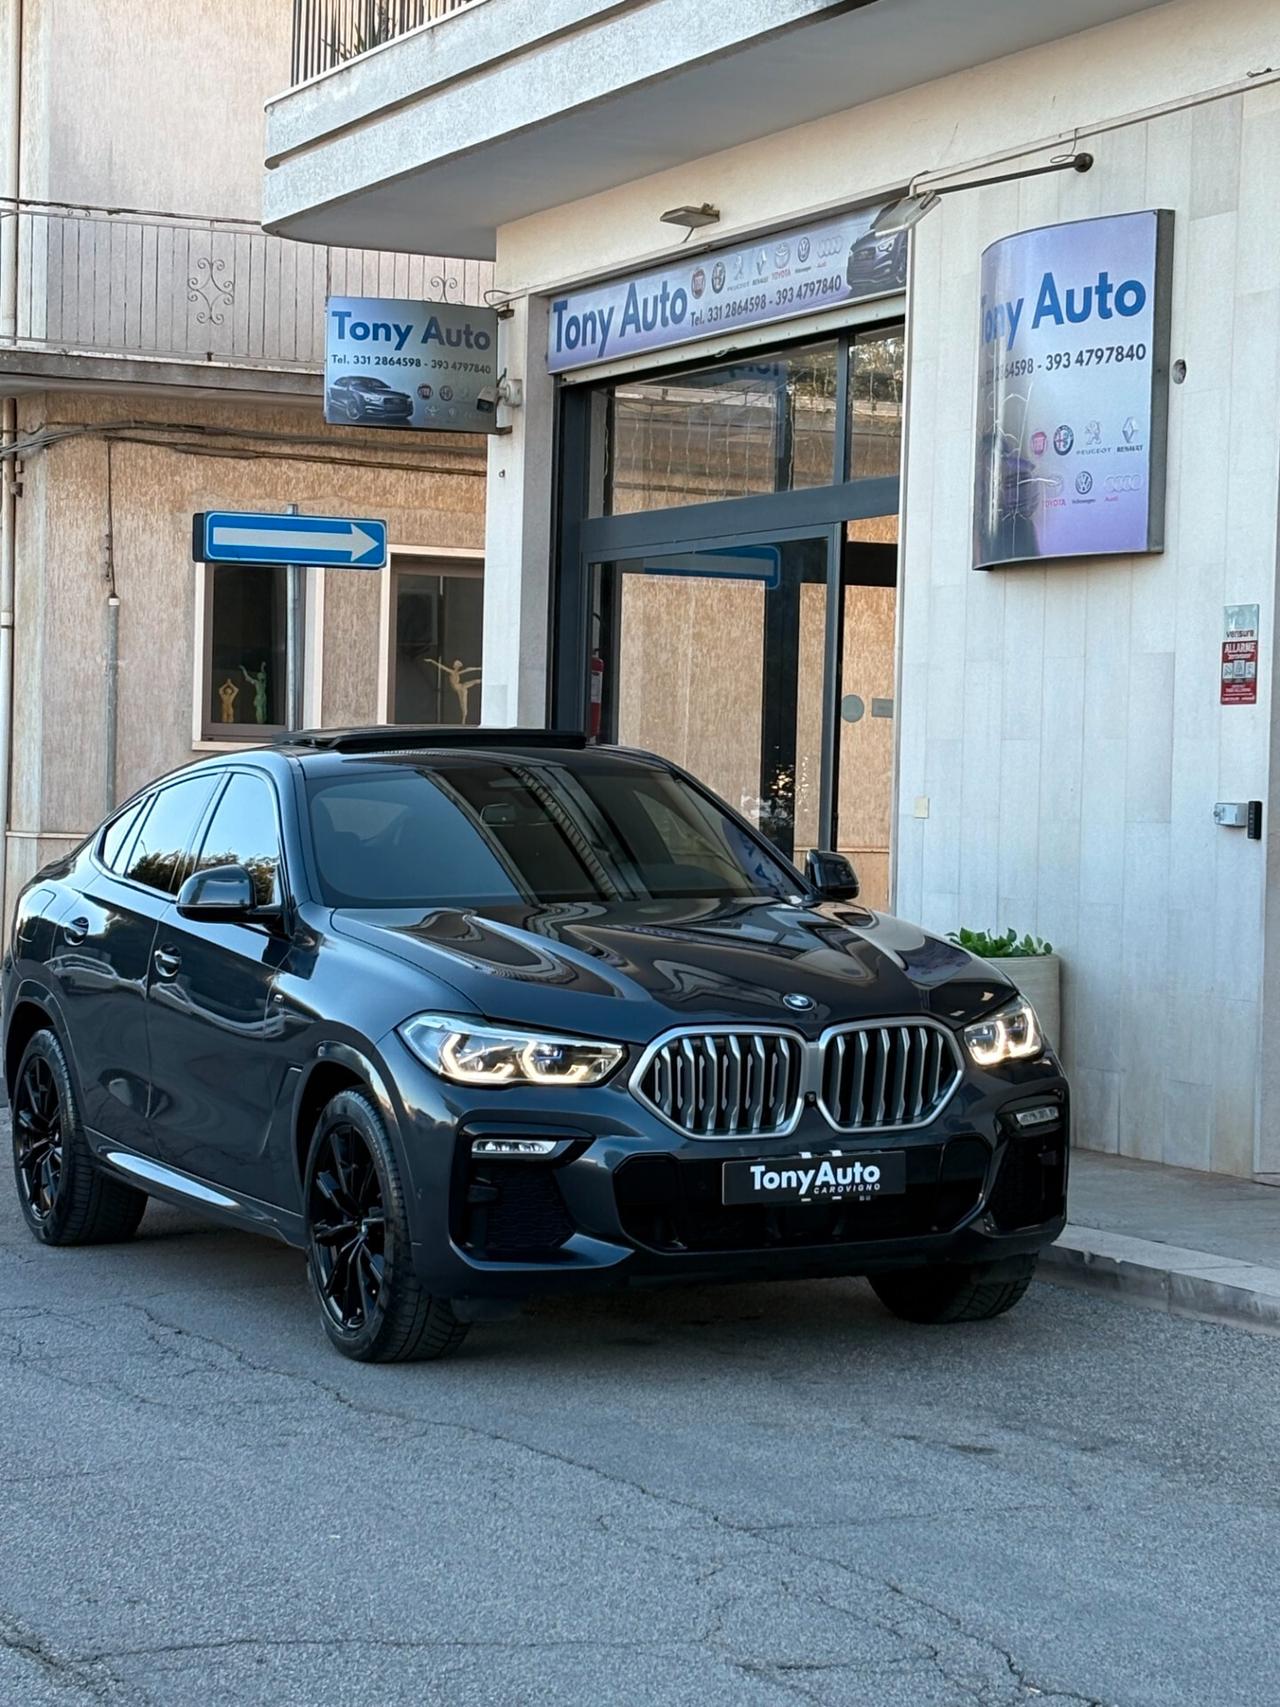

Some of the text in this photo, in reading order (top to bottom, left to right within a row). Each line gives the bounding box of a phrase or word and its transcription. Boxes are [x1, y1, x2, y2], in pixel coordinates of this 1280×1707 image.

[553, 281, 688, 358] Tony Auto
[690, 311, 705, 327] Tel.
[707, 307, 723, 322] 331
[725, 294, 767, 316] 2864598
[775, 286, 795, 305] 393
[795, 274, 842, 299] 4797840
[1031, 271, 1147, 330] Auto
[331, 311, 491, 351] Tony Auto
[331, 354, 350, 365] Tel.
[353, 355, 371, 365] 331
[374, 356, 422, 368] 2864598
[431, 359, 449, 369] 393
[451, 362, 491, 375] 4797840
[1045, 351, 1071, 372] 393
[1075, 343, 1147, 367] 4797840
[813, 1183, 881, 1194] CAROVIGNO
